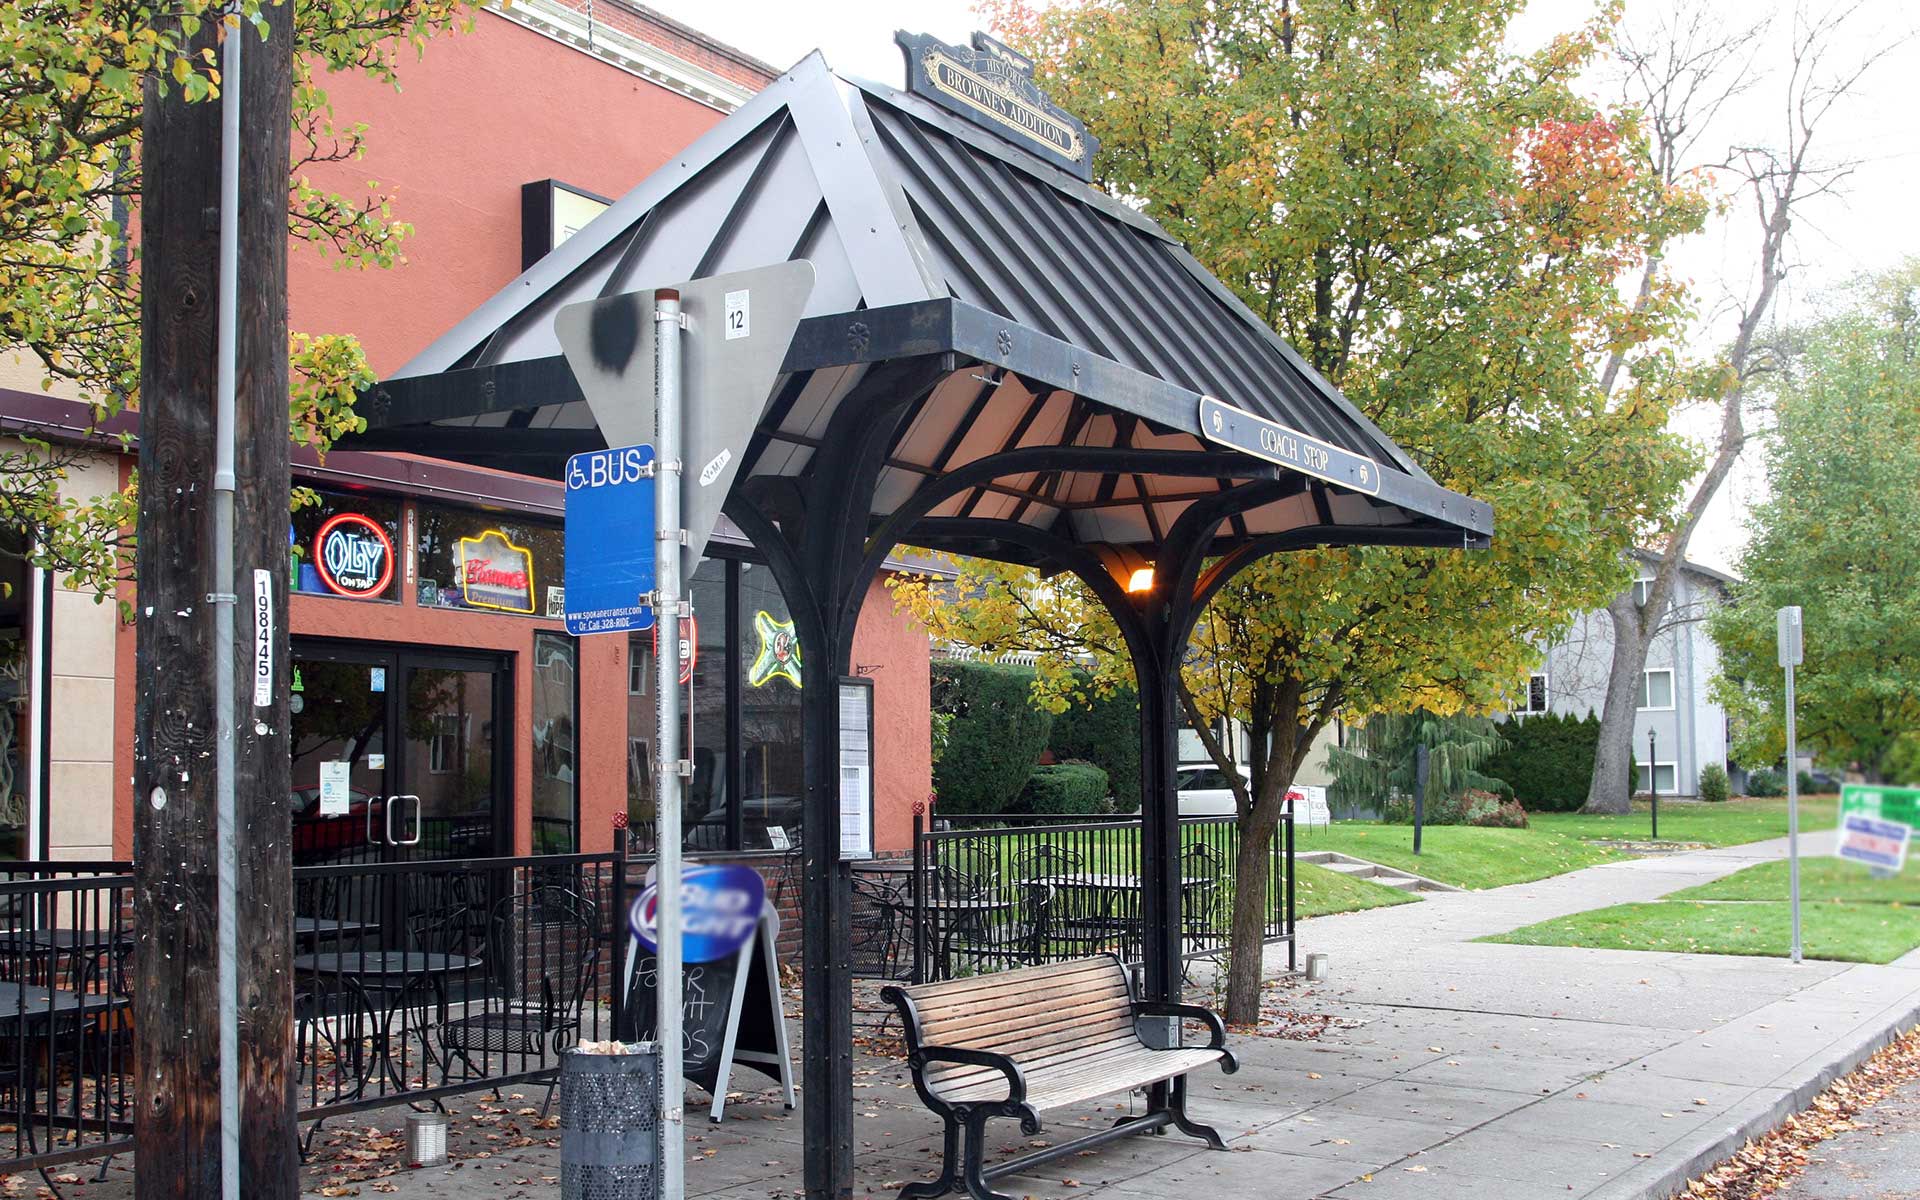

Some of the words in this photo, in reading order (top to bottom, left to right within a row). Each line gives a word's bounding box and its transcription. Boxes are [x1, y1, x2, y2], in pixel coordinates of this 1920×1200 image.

[986, 60, 1025, 88] HISTORIC
[947, 68, 1006, 115] BROWNE'S
[1009, 104, 1064, 147] ADDITION
[729, 310, 743, 329] 12
[591, 449, 641, 488] BUS
[1260, 427, 1298, 461] COACH
[1303, 444, 1328, 471] STOP
[325, 530, 384, 584] OLY
[257, 581, 269, 676] 198445
[568, 607, 642, 621] www.spokanetransit.com
[588, 620, 600, 631] Call
